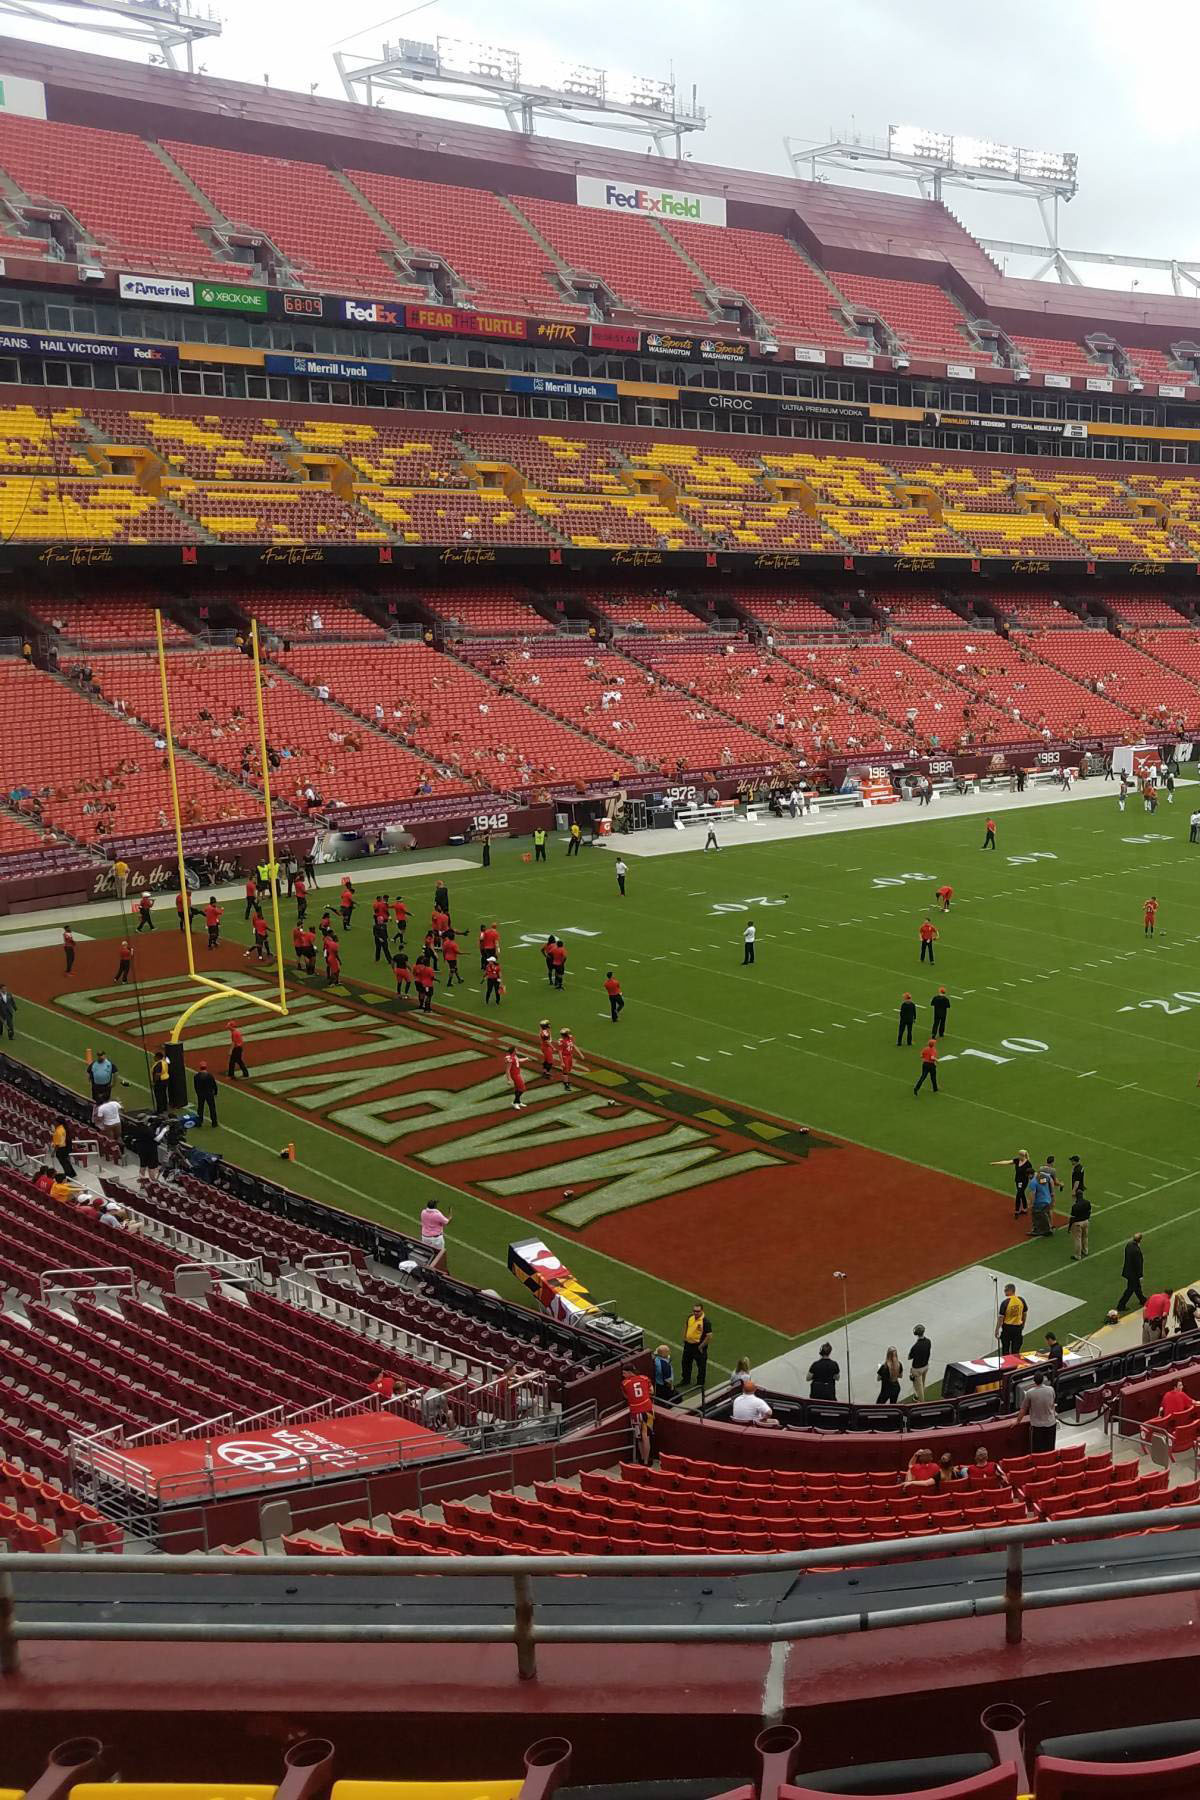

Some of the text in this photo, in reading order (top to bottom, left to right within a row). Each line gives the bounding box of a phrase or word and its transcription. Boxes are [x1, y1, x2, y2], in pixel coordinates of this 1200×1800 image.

[605, 185, 701, 218] FedExField
[134, 281, 190, 299] Ameritel
[216, 291, 261, 305] XBOX ONE
[286, 298, 321, 314] 68:09
[345, 301, 397, 325] FedEx
[40, 340, 66, 352] HAIL
[67, 343, 118, 356] VICTORY!
[660, 336, 694, 349] Sports
[714, 342, 747, 354] Sports
[133, 347, 161, 360] FedEx
[648, 347, 691, 356] WASHINGTON
[702, 352, 744, 362] WASHINGTON
[307, 361, 368, 378] Merrill Lynch
[545, 381, 597, 397] Merrill Lynch
[708, 395, 753, 410] CÎROC
[781, 404, 863, 417] ULTRA PREMIUM VODKA
[1038, 752, 1060, 764] 1983
[928, 761, 953, 774] 1982
[667, 786, 697, 803] 1972
[473, 814, 509, 831] 1942
[132, 872, 145, 886] to
[150, 865, 172, 884] the
[960, 1038, 1052, 1065] 10
[633, 1382, 643, 1398] 6
